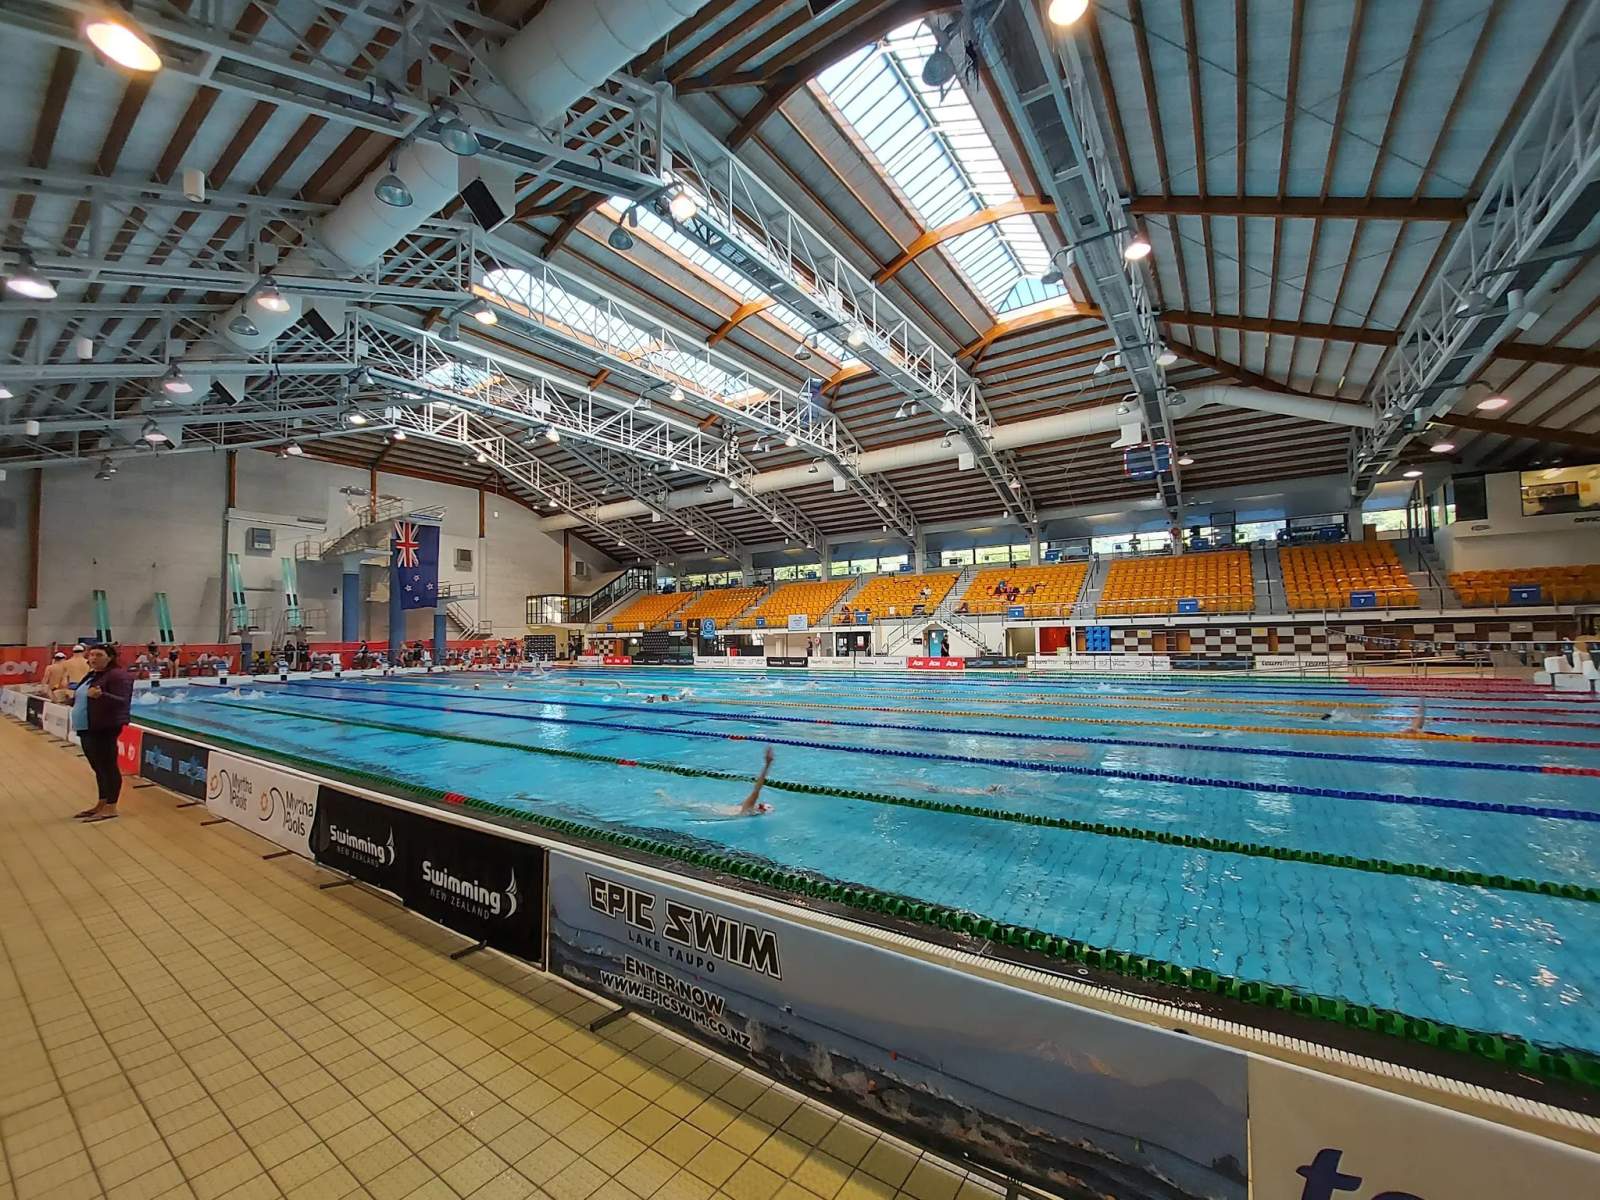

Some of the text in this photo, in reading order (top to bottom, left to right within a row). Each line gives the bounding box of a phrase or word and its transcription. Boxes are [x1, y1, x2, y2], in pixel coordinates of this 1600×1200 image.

[329, 824, 386, 864] Swimming
[422, 860, 501, 915] Swimming
[430, 887, 447, 902] NEW
[450, 895, 490, 920] ZEALAND
[585, 872, 783, 980] EPIC SWIM
[628, 930, 716, 974] LAKE TAUPO
[624, 953, 726, 1017] ENTER NOW
[600, 970, 753, 1052] WWW.EPICSWIM.CO.NZ
